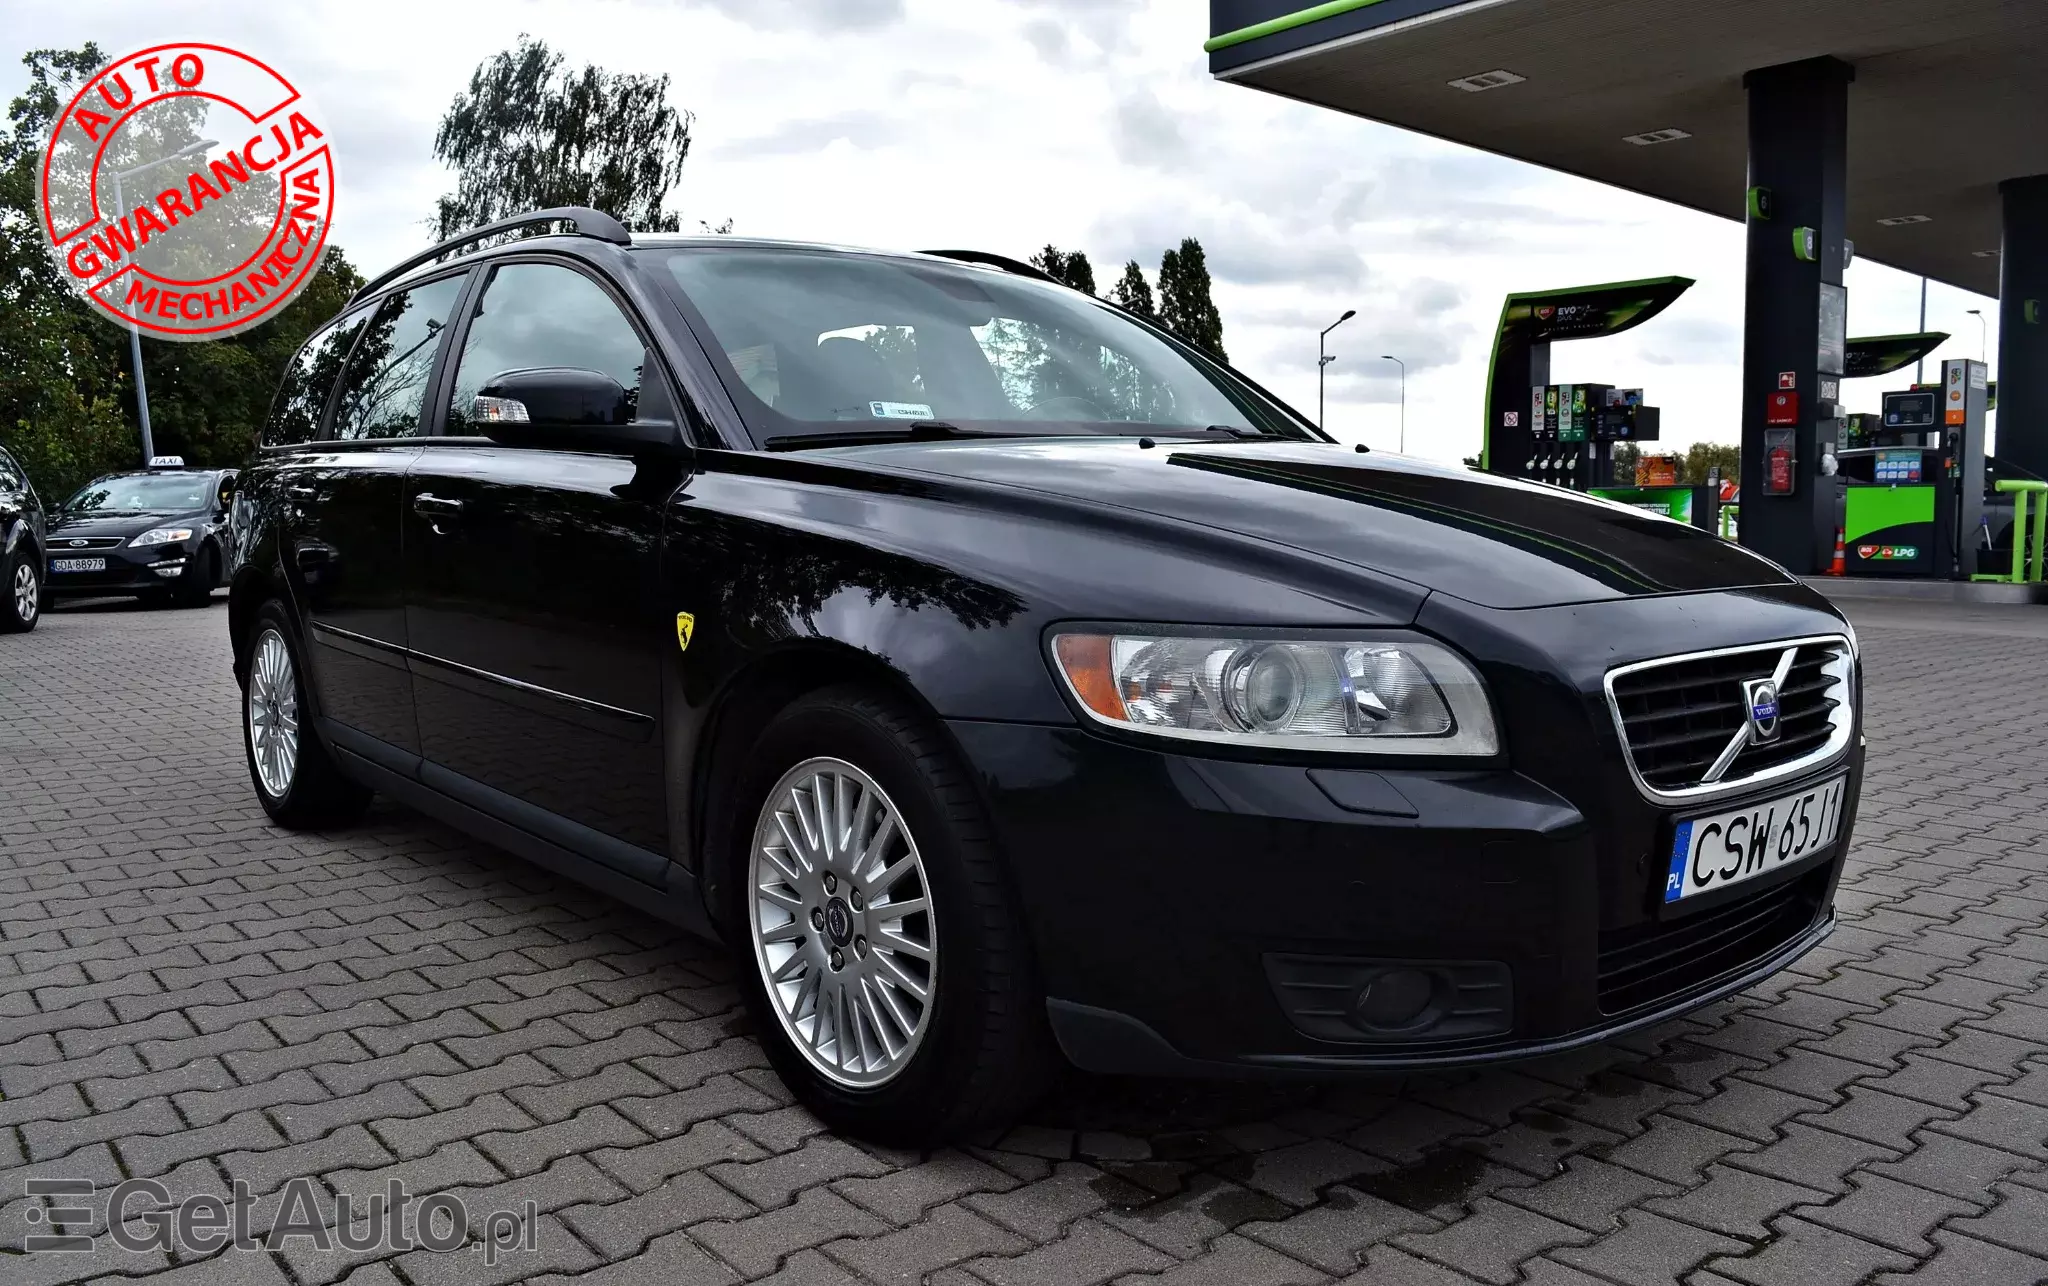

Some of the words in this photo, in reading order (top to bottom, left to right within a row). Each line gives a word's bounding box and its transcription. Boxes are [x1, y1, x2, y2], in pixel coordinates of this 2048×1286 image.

[1807, 236, 1813, 250] 8
[1558, 306, 1577, 316] EVO
[155, 457, 177, 465] TAXI
[1894, 548, 1915, 557] LPG
[55, 560, 73, 570] GDA
[75, 559, 104, 569] 88979
[1692, 806, 1774, 888] CSW
[1778, 782, 1840, 861] 65J1
[1666, 871, 1681, 891] PL
